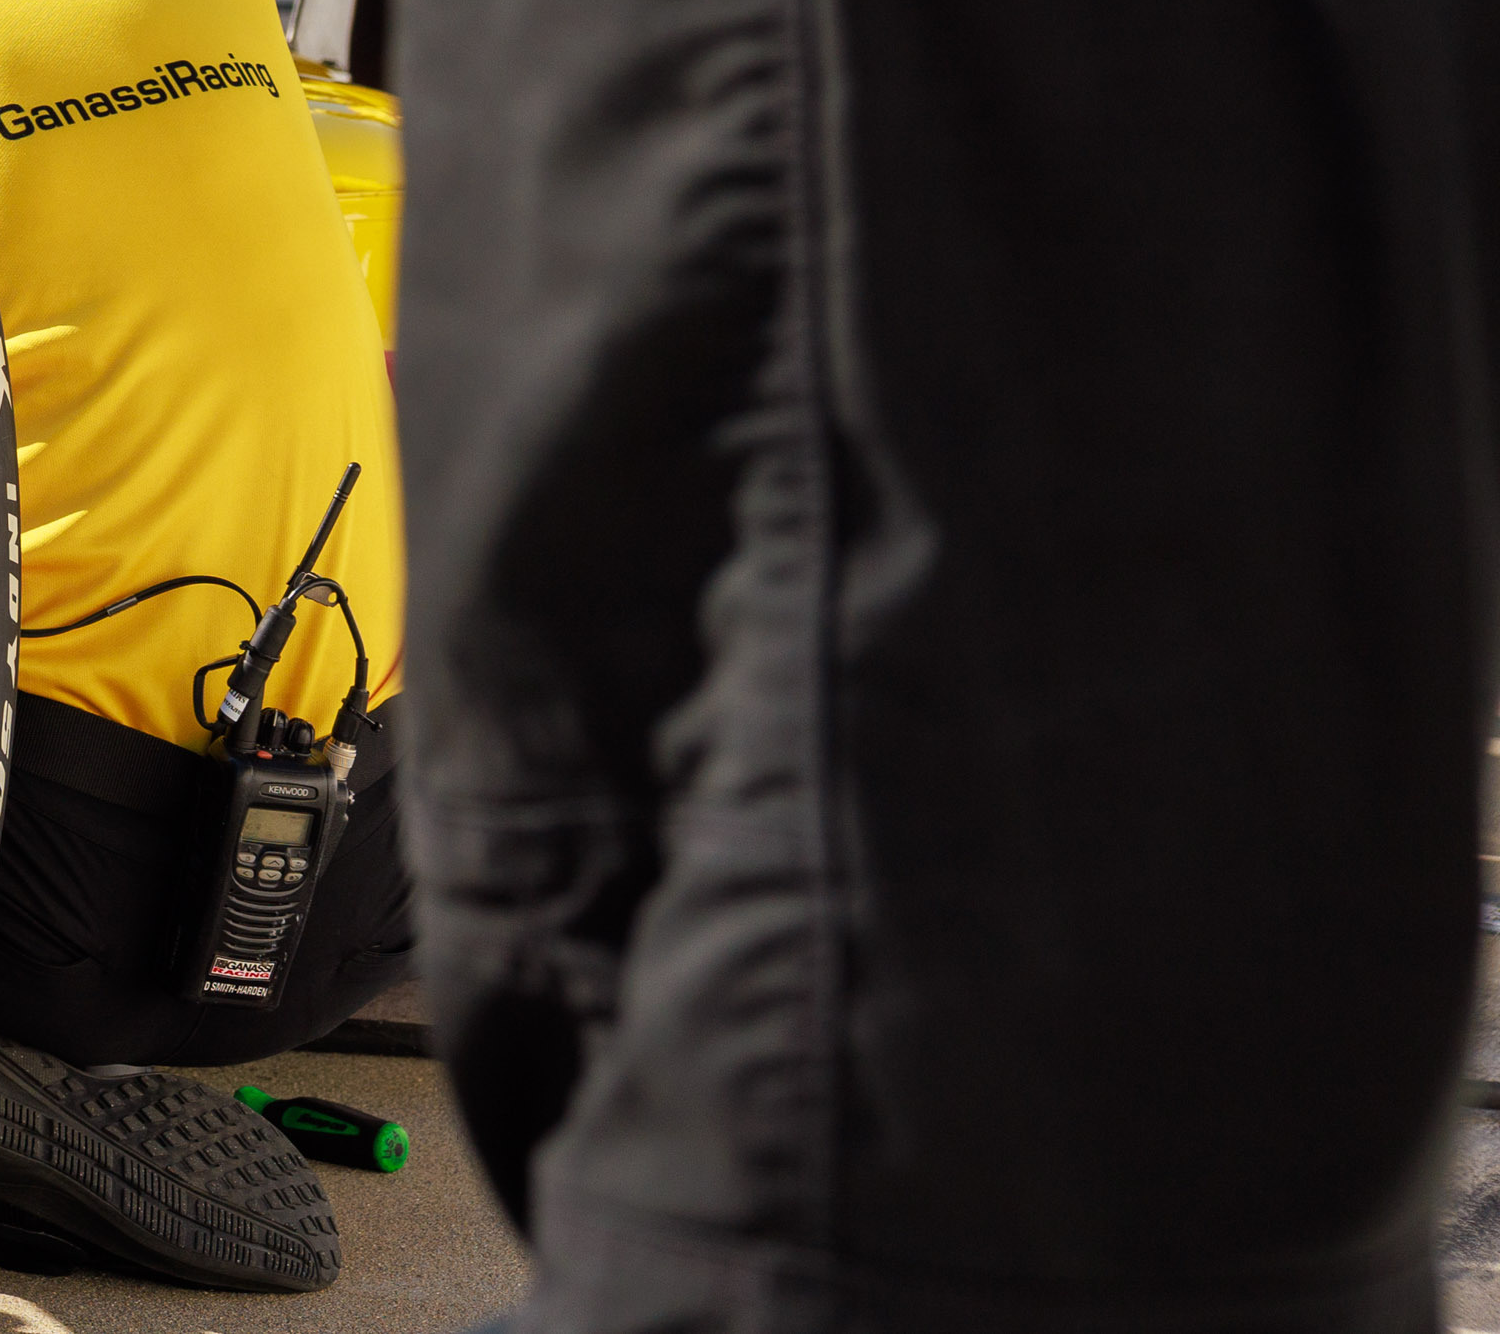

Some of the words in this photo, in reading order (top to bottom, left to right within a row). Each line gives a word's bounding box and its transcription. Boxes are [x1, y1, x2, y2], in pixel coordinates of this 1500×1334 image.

[5, 481, 22, 691] INDY
[268, 785, 310, 798] KENWOOD
[212, 966, 271, 980] RACING
[225, 958, 275, 975] GANASSI
[203, 980, 211, 992] D
[210, 982, 268, 998] SMITH-HARDEN
